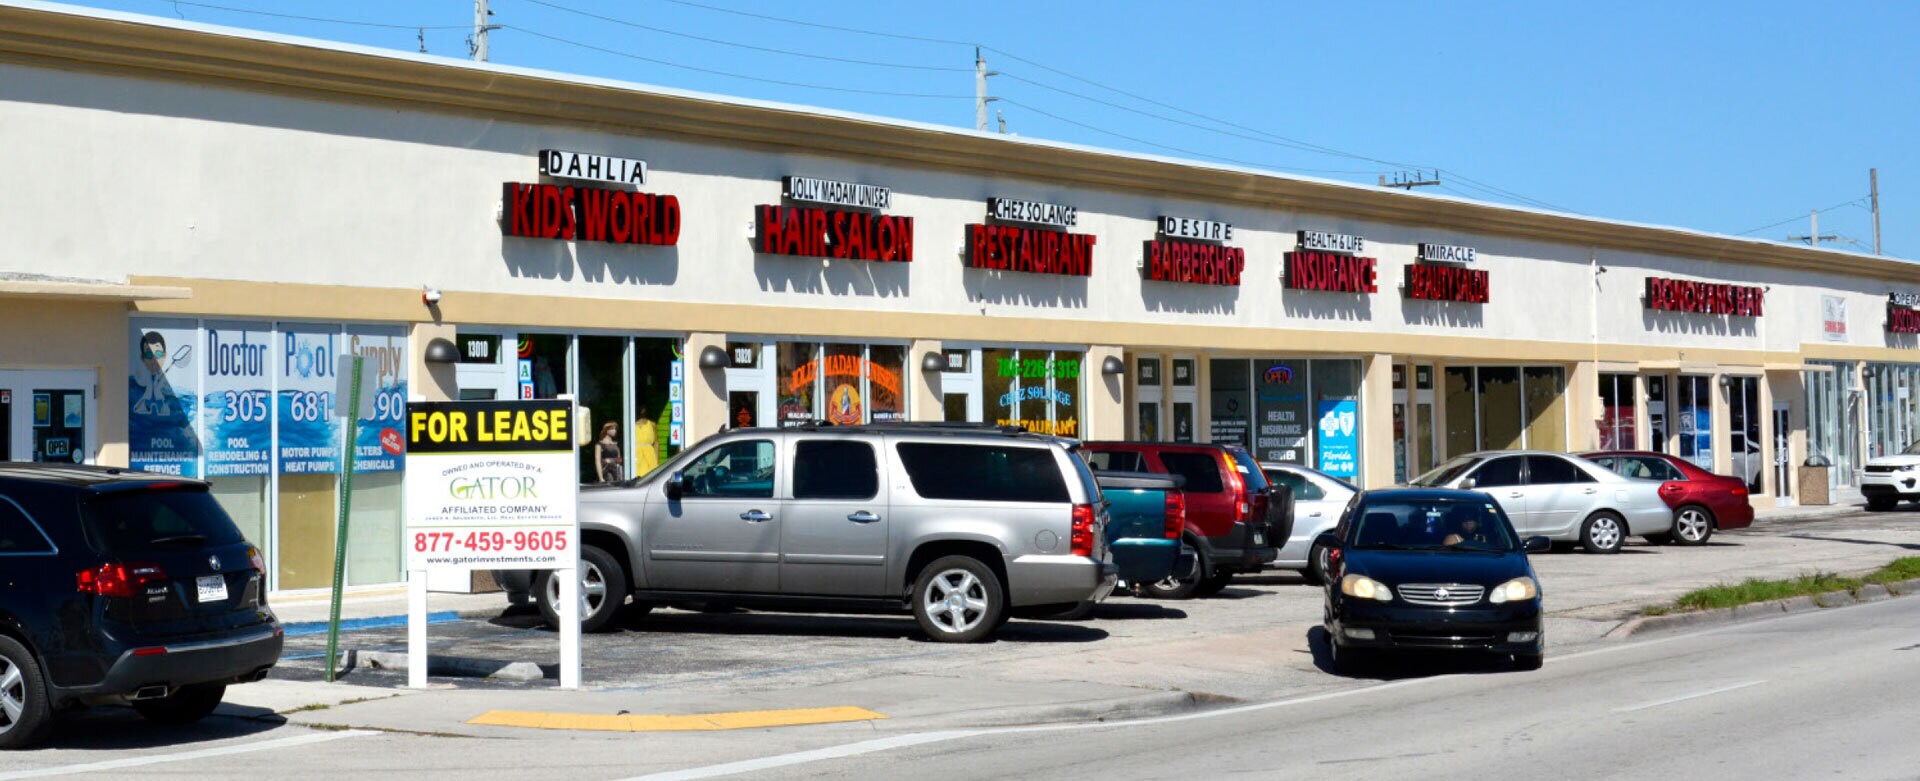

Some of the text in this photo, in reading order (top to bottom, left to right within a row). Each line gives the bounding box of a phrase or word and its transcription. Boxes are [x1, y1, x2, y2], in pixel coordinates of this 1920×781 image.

[550, 151, 644, 184] DAHLIA
[790, 177, 890, 209] JOLLY MADAM UNISEX
[511, 182, 681, 246] KIDS WORLD
[995, 199, 1077, 226] CHEZ SOLANGE
[763, 205, 913, 262] HAIR SALON
[1166, 217, 1232, 240] DESIRE
[1305, 231, 1363, 251] HEALTH & LIFE
[973, 223, 1097, 276] RESTAURANT
[1426, 245, 1474, 262] MIRACLE
[1150, 241, 1245, 286] BARBERSHOP
[1290, 251, 1378, 293] INSURANCE
[1411, 264, 1489, 303] BEAUTY SALON
[1651, 277, 1763, 316] DONOVANS BAR
[467, 340, 489, 358] 13010
[208, 329, 402, 390] Doctor Pool Sply
[520, 363, 530, 377] A
[674, 366, 679, 377] 1
[789, 354, 898, 395] JOLLY MADAM UNISEX
[1264, 369, 1291, 384] OPEN
[523, 386, 532, 399] B
[672, 386, 679, 397] 2
[999, 386, 1072, 407] CHEZ SOLANGE
[224, 390, 404, 422] 305 681 90
[674, 406, 681, 418] 3
[1267, 411, 1295, 421] HEALTH
[411, 409, 568, 443] FOR LEASE
[1262, 425, 1302, 435] INSURANCE
[672, 428, 679, 440] 4
[48, 440, 68, 454] OPEN
[151, 438, 174, 448] POOL
[227, 438, 249, 448] POOL
[1259, 437, 1305, 447] ENROLLMENT
[131, 451, 194, 462] MAINTENANCE
[208, 450, 267, 461] REMODELING &
[281, 447, 339, 458] MOTOR PUMPS
[355, 446, 383, 456] ILTERS
[1268, 450, 1296, 460] CENTER
[1323, 450, 1352, 460] Florida
[143, 464, 181, 475] SERVICE
[207, 463, 269, 474] CONSTRUCTION
[285, 461, 335, 472] HEAT PUMPS
[442, 463, 468, 477] OWNED
[469, 461, 485, 469] AND
[486, 460, 524, 470] OPERATED
[525, 463, 536, 472] BY
[449, 476, 538, 500] GATOR
[441, 505, 548, 514] AFFILIATED COMPANY
[414, 530, 567, 553] 877-459-9605
[427, 555, 557, 565] www.gatorinvestments.com
